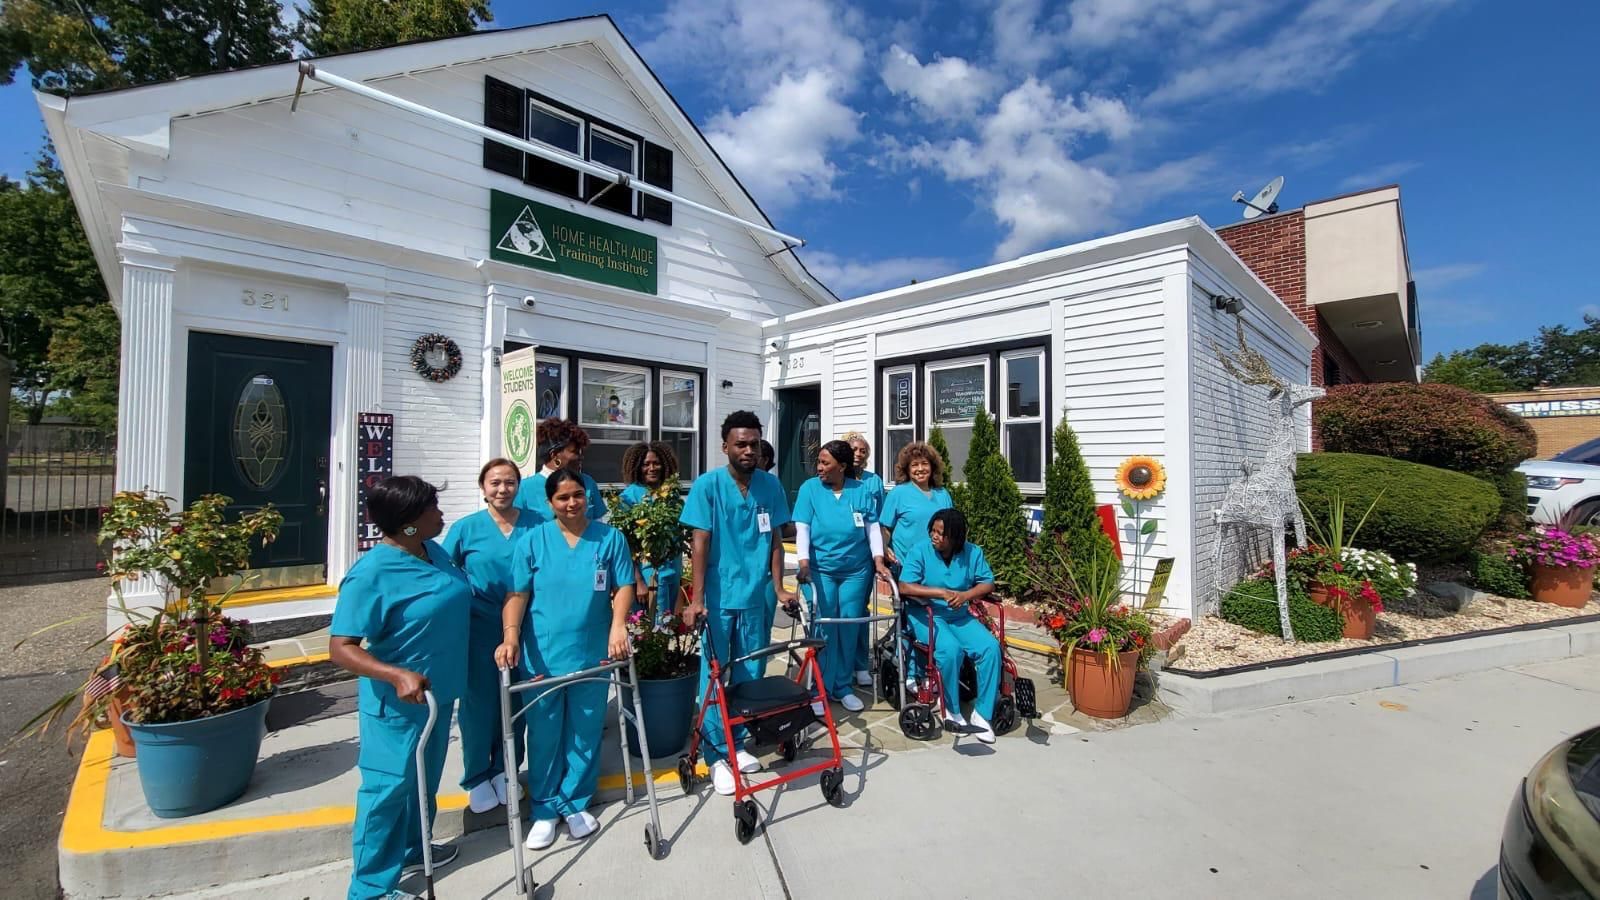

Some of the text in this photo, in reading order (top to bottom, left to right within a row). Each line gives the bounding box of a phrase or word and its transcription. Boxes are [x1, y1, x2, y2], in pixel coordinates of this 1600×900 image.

[552, 224, 654, 265] HOME HEALTH AIDE
[558, 243, 649, 277] Training Institute
[242, 288, 290, 311] 321
[503, 366, 533, 381] WELCOME
[503, 379, 534, 394] STUDENTS
[900, 381, 908, 418] OPEN
